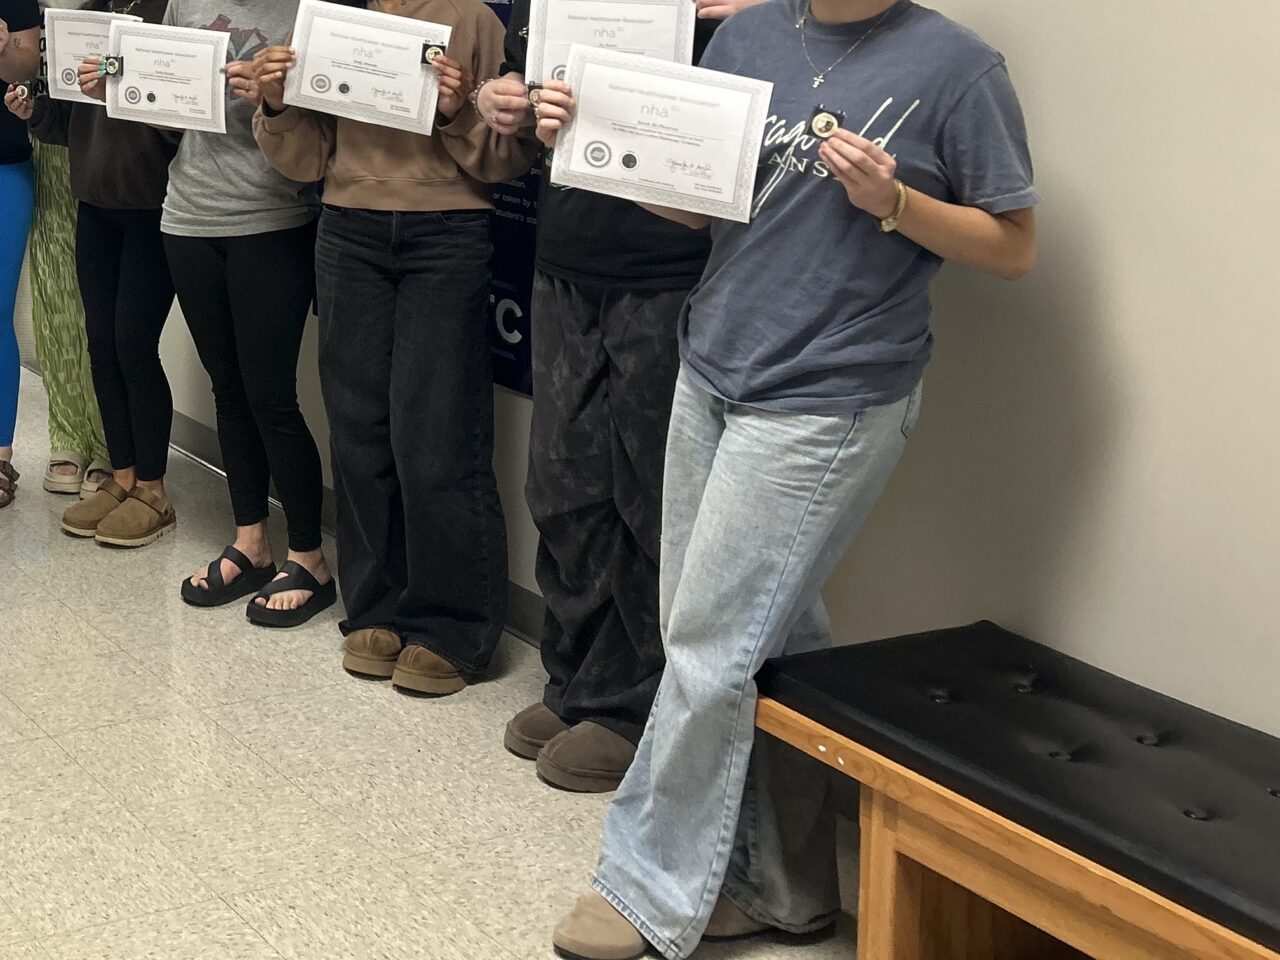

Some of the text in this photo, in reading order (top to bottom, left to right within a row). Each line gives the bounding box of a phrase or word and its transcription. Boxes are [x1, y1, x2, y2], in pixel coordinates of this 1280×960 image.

[594, 27, 616, 38] nha
[86, 41, 100, 49] nha
[154, 59, 171, 68] nha
[640, 104, 669, 118] nha
